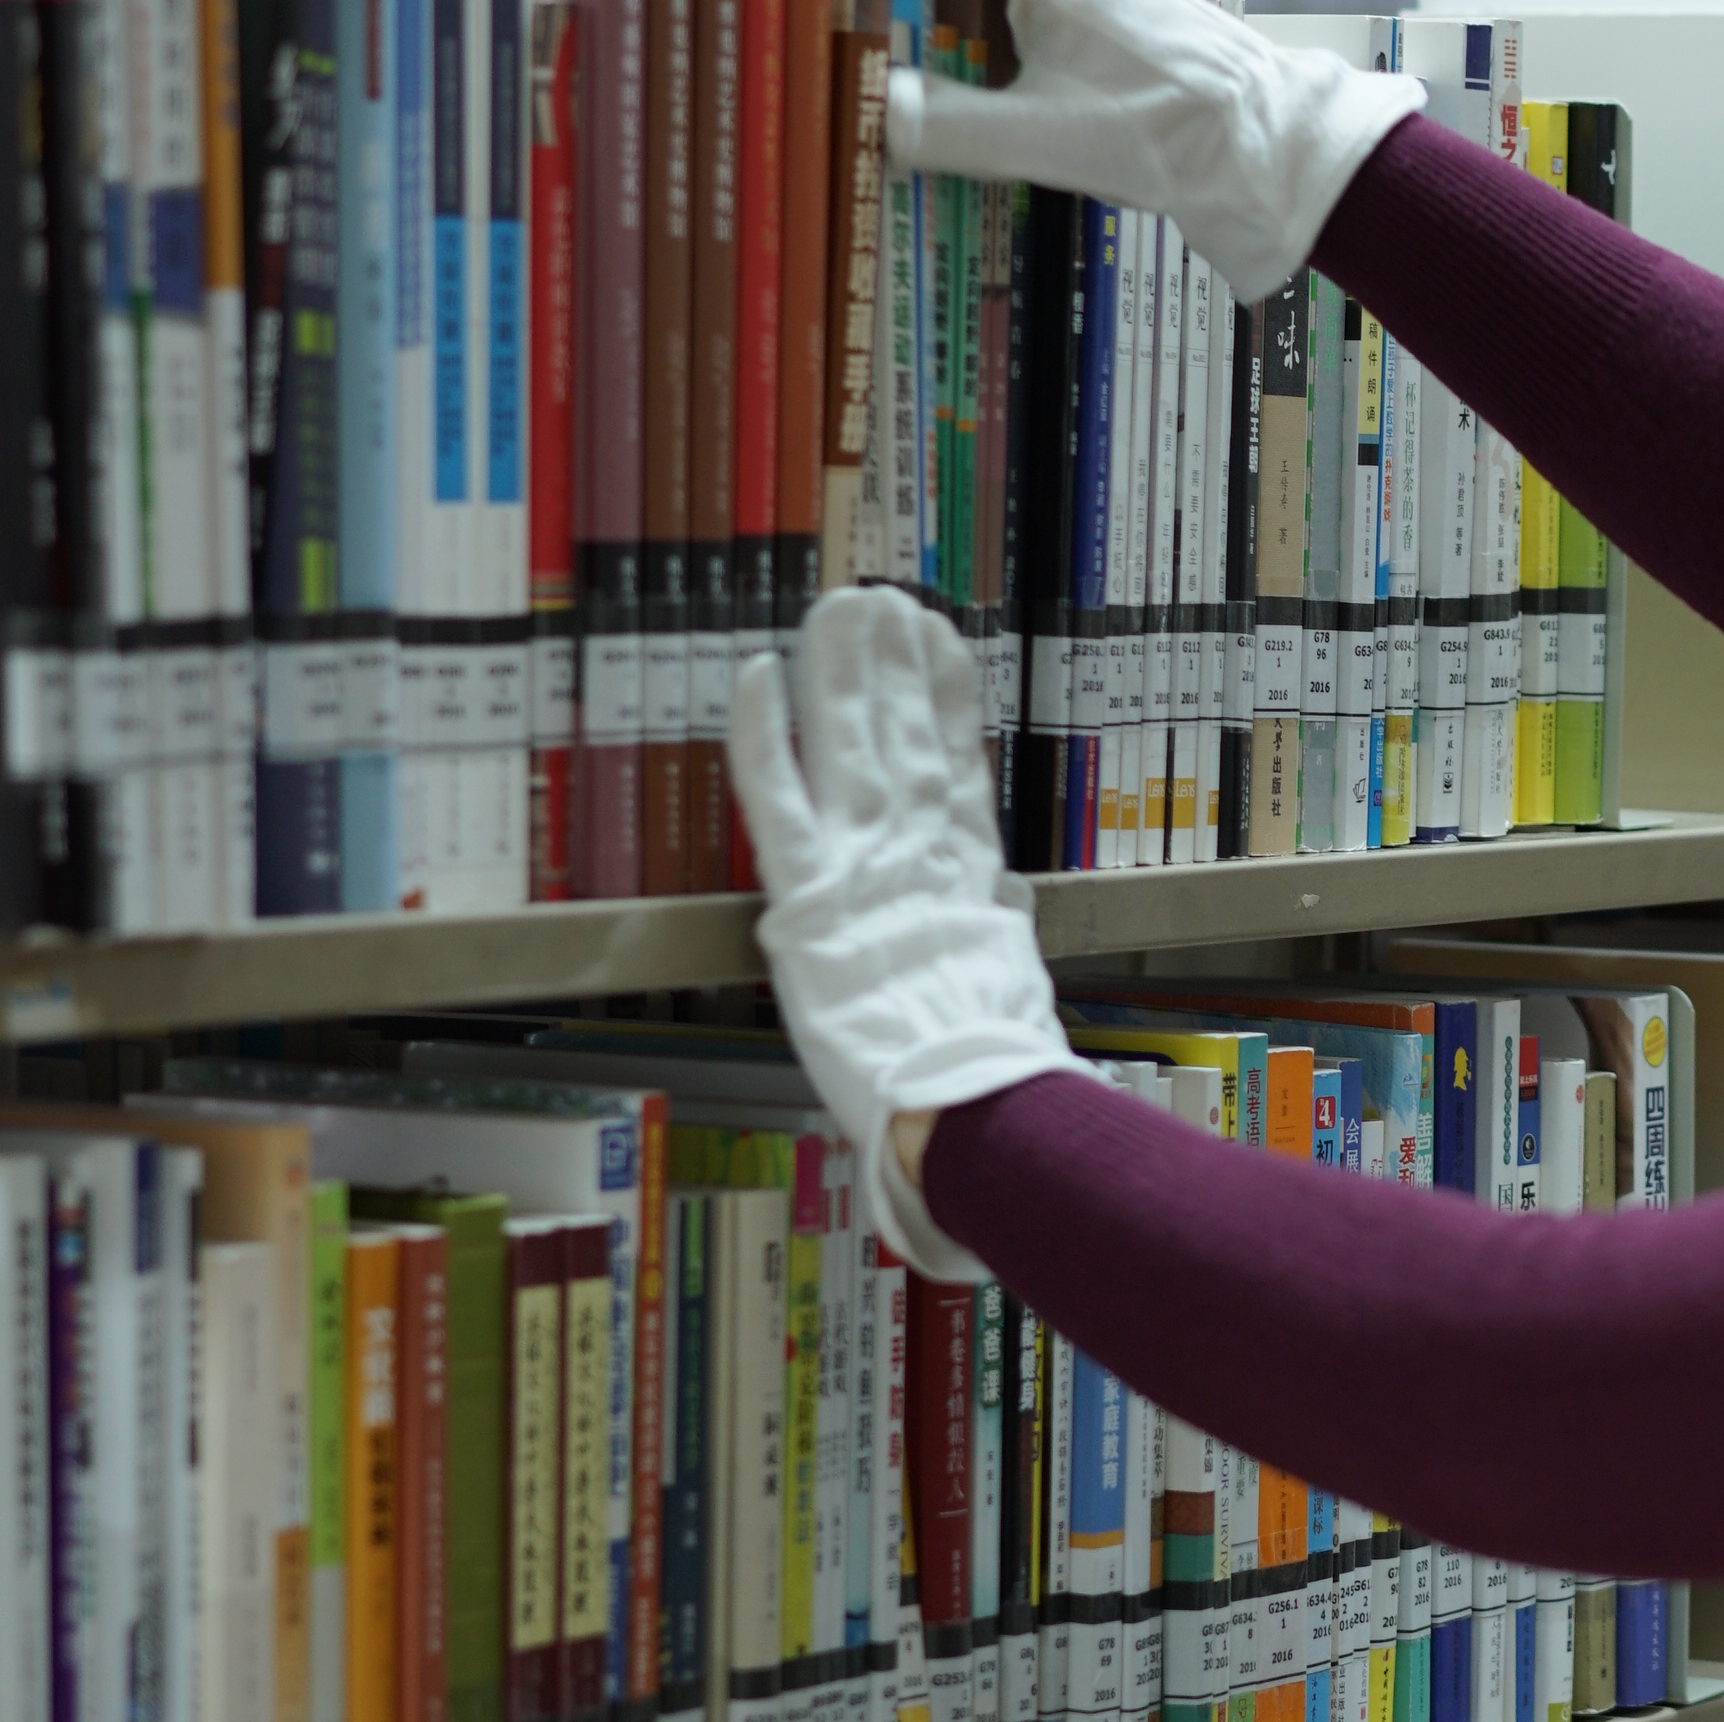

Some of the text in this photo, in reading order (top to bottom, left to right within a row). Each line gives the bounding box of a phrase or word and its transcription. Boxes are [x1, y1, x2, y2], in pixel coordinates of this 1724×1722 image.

[1501, 104, 1518, 163] 恒之
[1403, 380, 1417, 551] 杯记得茶的香
[1313, 631, 1331, 644] G78
[1264, 639, 1293, 653] G219.2
[1440, 641, 1468, 653] G254.9
[1315, 648, 1328, 660] 96
[1448, 673, 1467, 685] 2016
[1490, 677, 1509, 689] 2016
[1309, 681, 1331, 694] 2016
[1181, 692, 1199, 705] 2016
[1267, 689, 1289, 702] 2016
[1173, 777, 1197, 798] Lens
[1324, 1098, 1335, 1128] 4
[1316, 1138, 1333, 1167] 初
[1345, 1118, 1360, 1173] 会展
[1399, 1136, 1417, 1188] 爱和
[1519, 1181, 1536, 1208] 乐
[981, 1283, 1004, 1408] 爸爸课
[945, 1308, 967, 1504] 书卷多情似故人
[1103, 1373, 1120, 1491] 家庭教育
[1416, 1559, 1429, 1573] G78
[1446, 1558, 1460, 1572] 110
[1418, 1577, 1426, 1589] 82
[1443, 1576, 1462, 1589] 2016
[1487, 1573, 1507, 1588] 2016
[1414, 1592, 1430, 1606] 2016
[1268, 1598, 1299, 1616] G256.1
[1271, 1649, 1293, 1666] 2016
[1094, 1688, 1116, 1703] 2016
